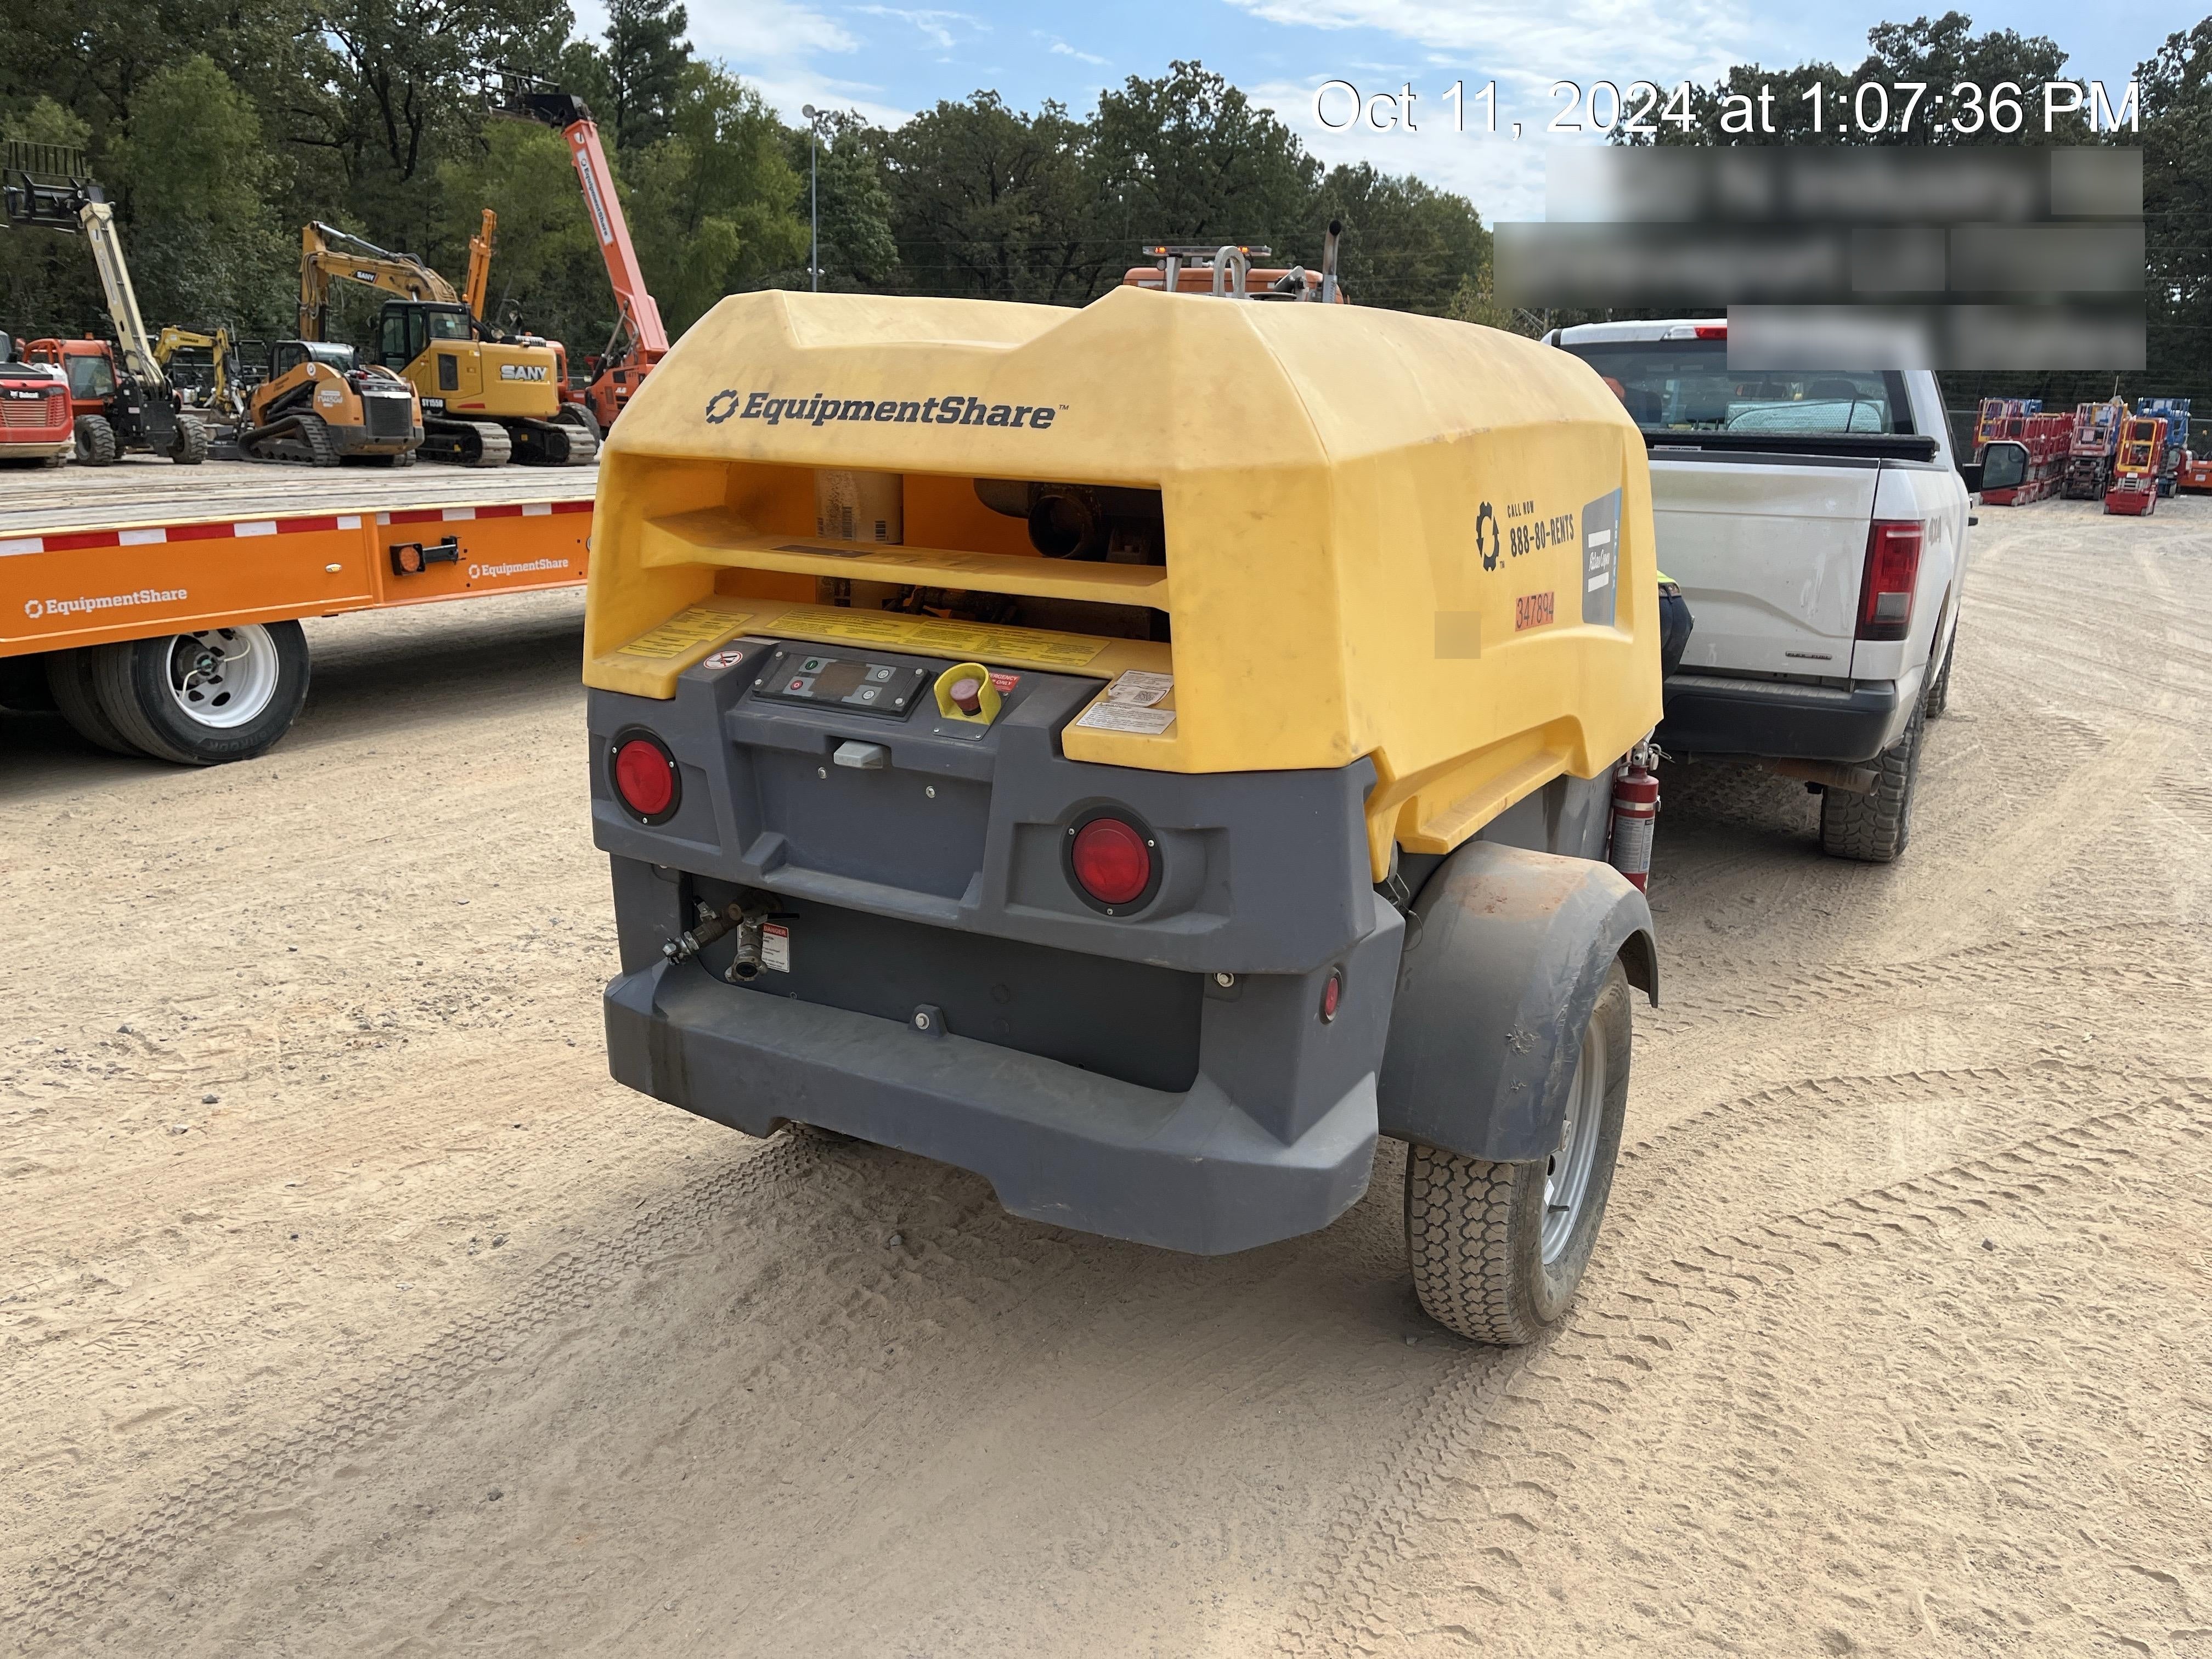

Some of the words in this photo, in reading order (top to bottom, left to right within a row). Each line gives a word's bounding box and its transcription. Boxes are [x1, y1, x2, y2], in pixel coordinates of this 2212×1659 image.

[500, 365, 547, 380] SANY
[740, 393, 1056, 429] EquipmentShare
[1507, 503, 1521, 518] CALL
[1522, 500, 1534, 515] NOW
[1510, 514, 1574, 557] 888-80-RENTS
[482, 558, 568, 577] EquipmentShare
[46, 589, 188, 615] EquipmentShare
[1517, 592, 1554, 629] 347894
[763, 926, 786, 935] DANGER
